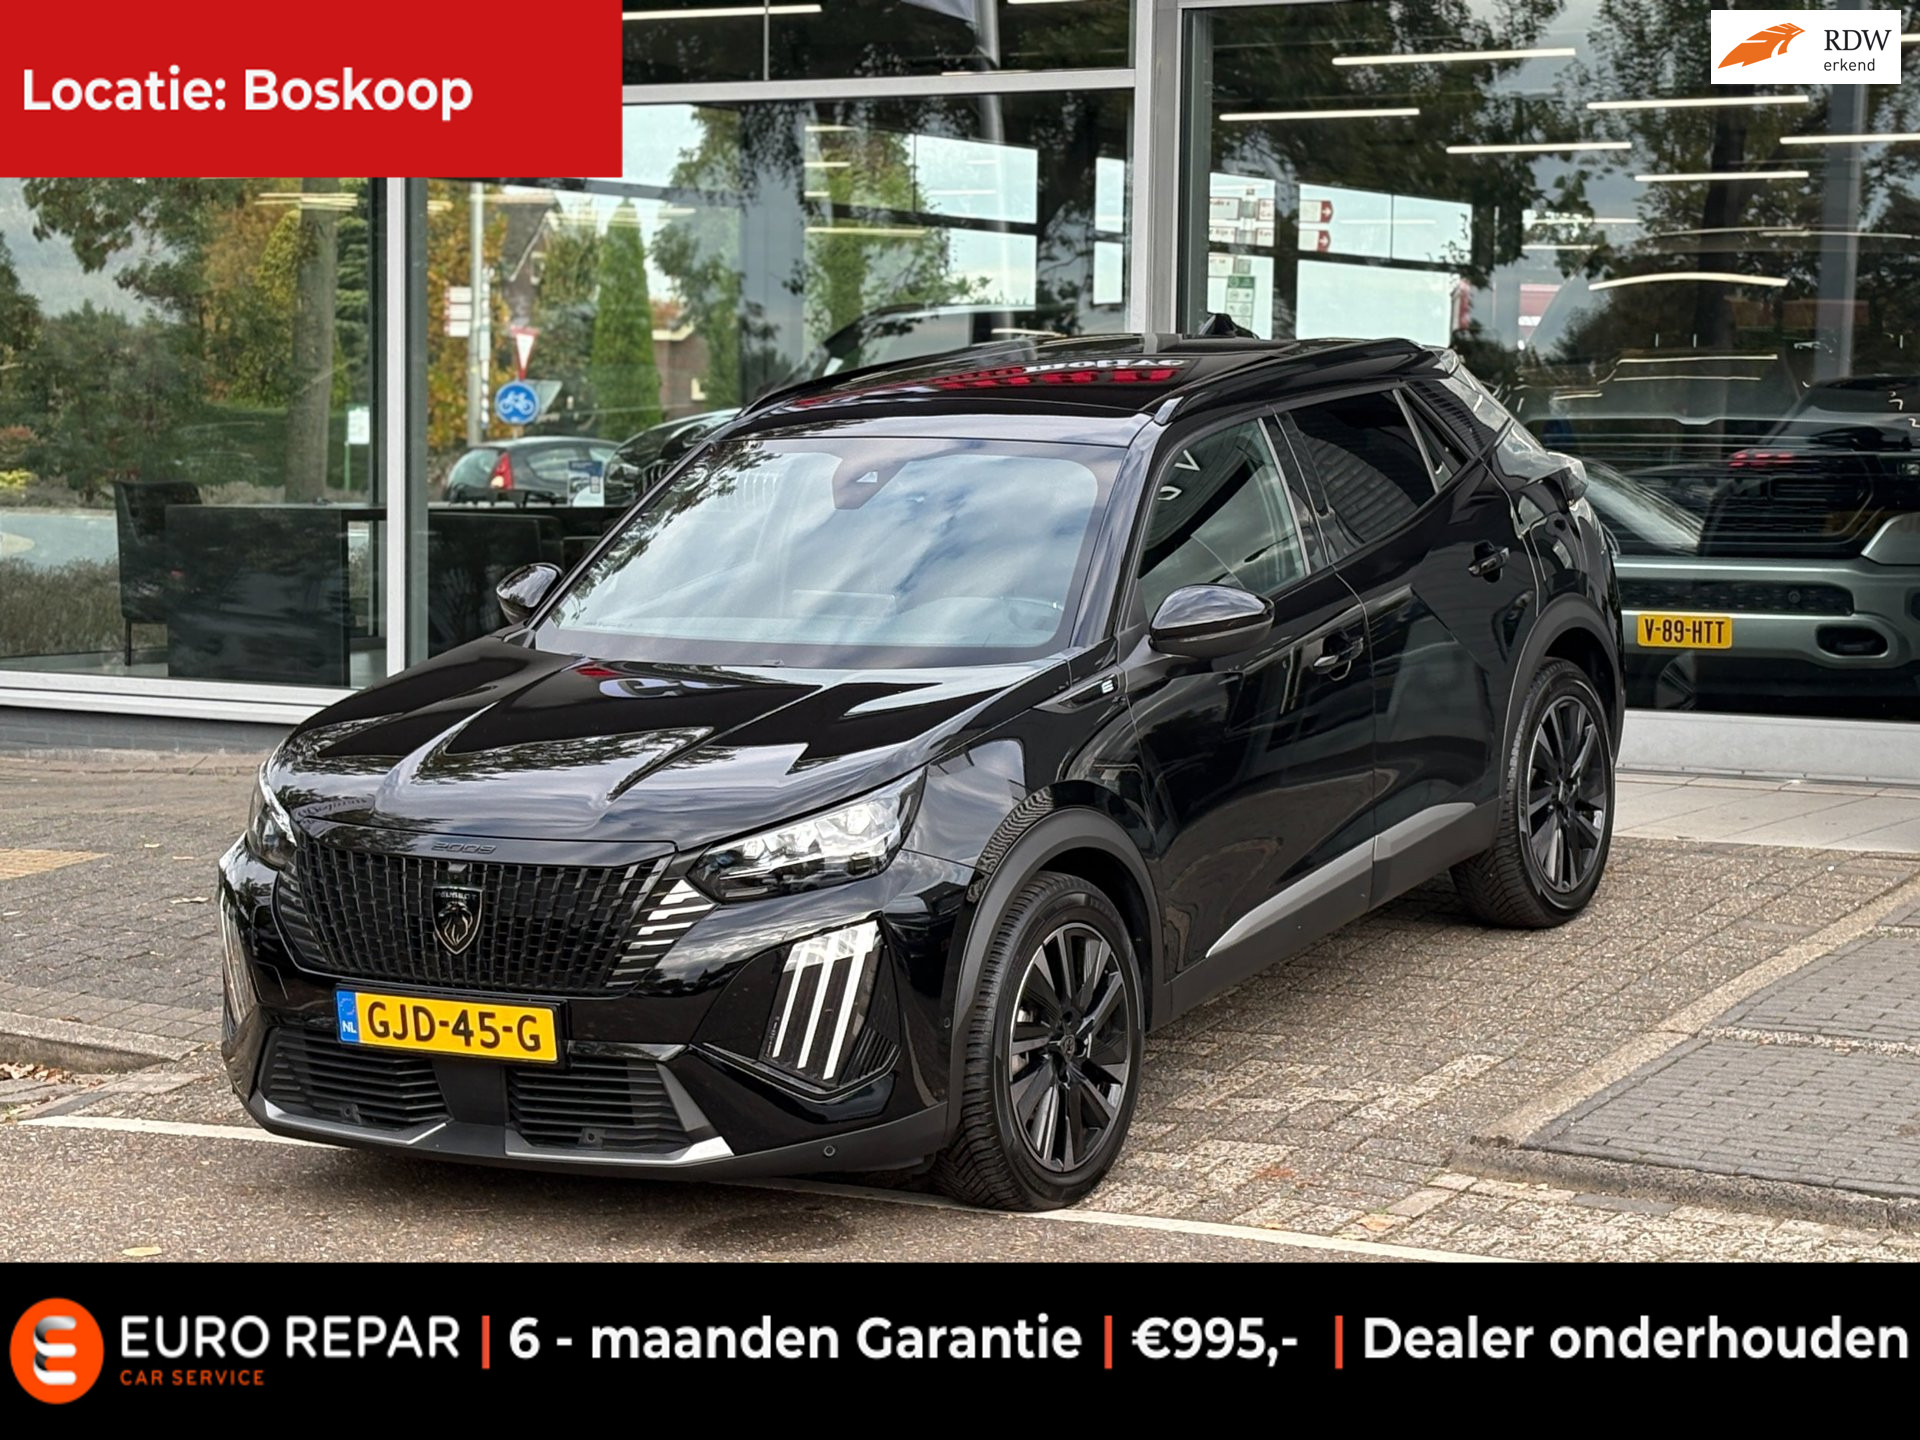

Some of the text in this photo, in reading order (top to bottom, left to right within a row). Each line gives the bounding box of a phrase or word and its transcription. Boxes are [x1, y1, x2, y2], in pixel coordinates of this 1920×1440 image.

[1644, 618, 1725, 644] V-89-HTT
[341, 1020, 357, 1034] NL
[367, 1001, 542, 1053] GJD-45-G
